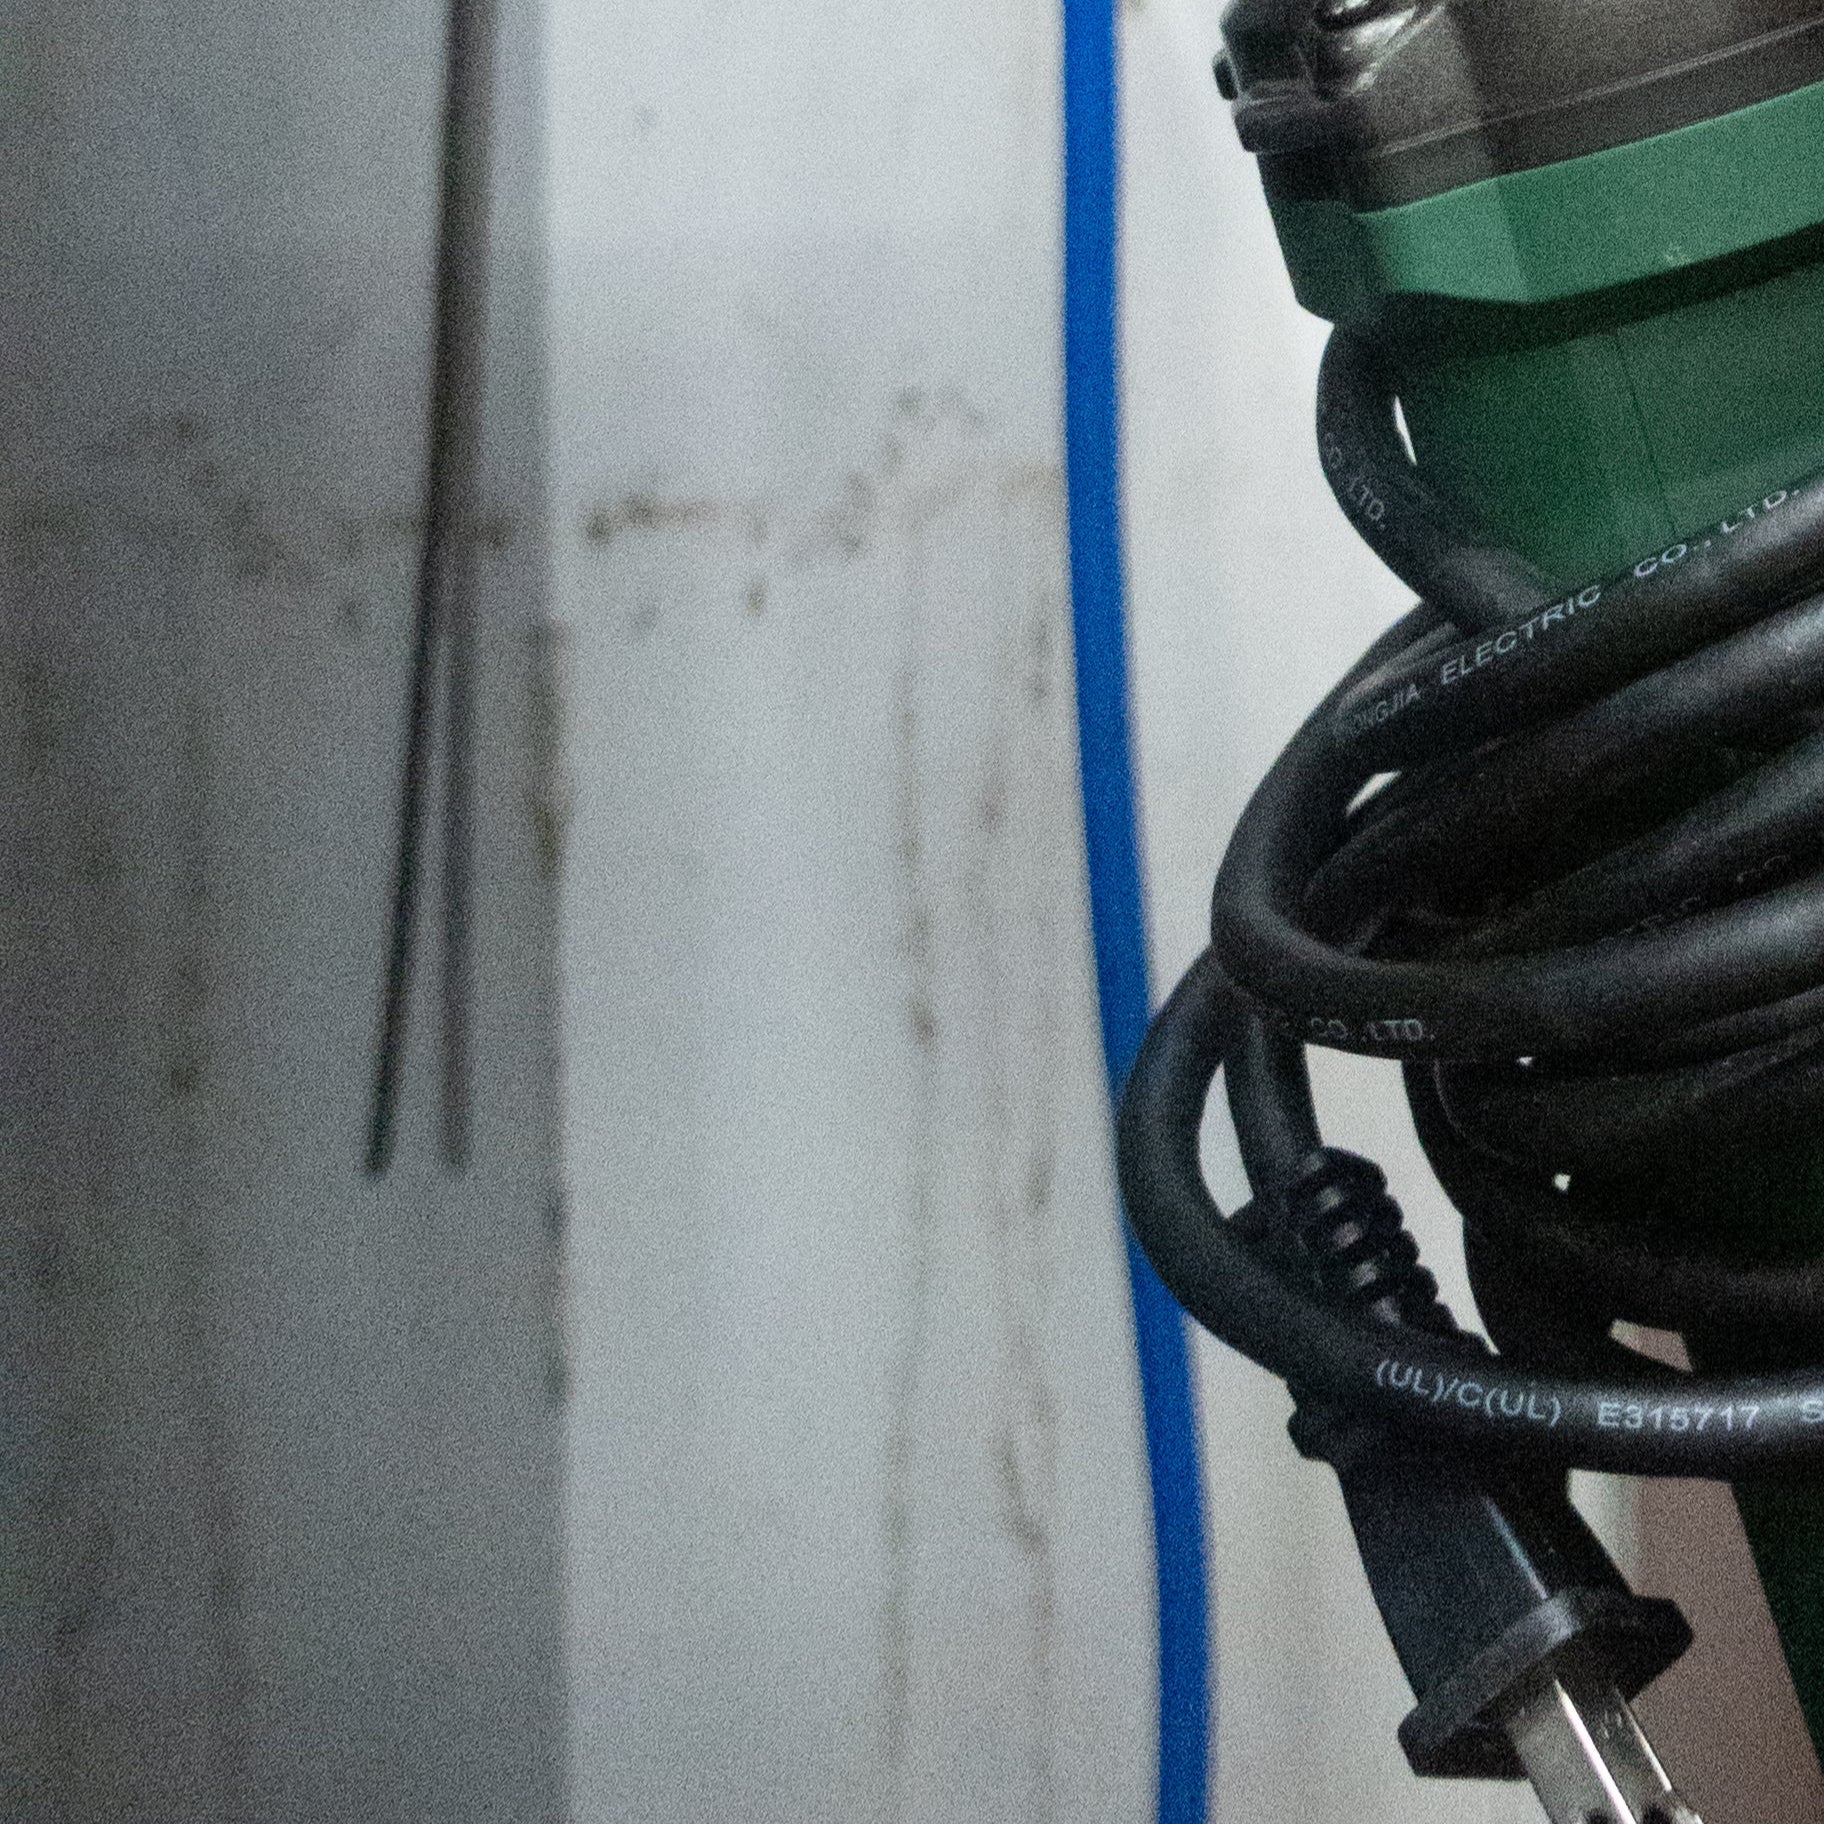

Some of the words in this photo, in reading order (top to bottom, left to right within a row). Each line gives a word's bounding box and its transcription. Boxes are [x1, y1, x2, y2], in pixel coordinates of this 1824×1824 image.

[1438, 583, 1602, 686] ELECTRIC
[1374, 1358, 1562, 1428] (UL)/C(UL)
[1596, 1401, 1760, 1431] E315717
